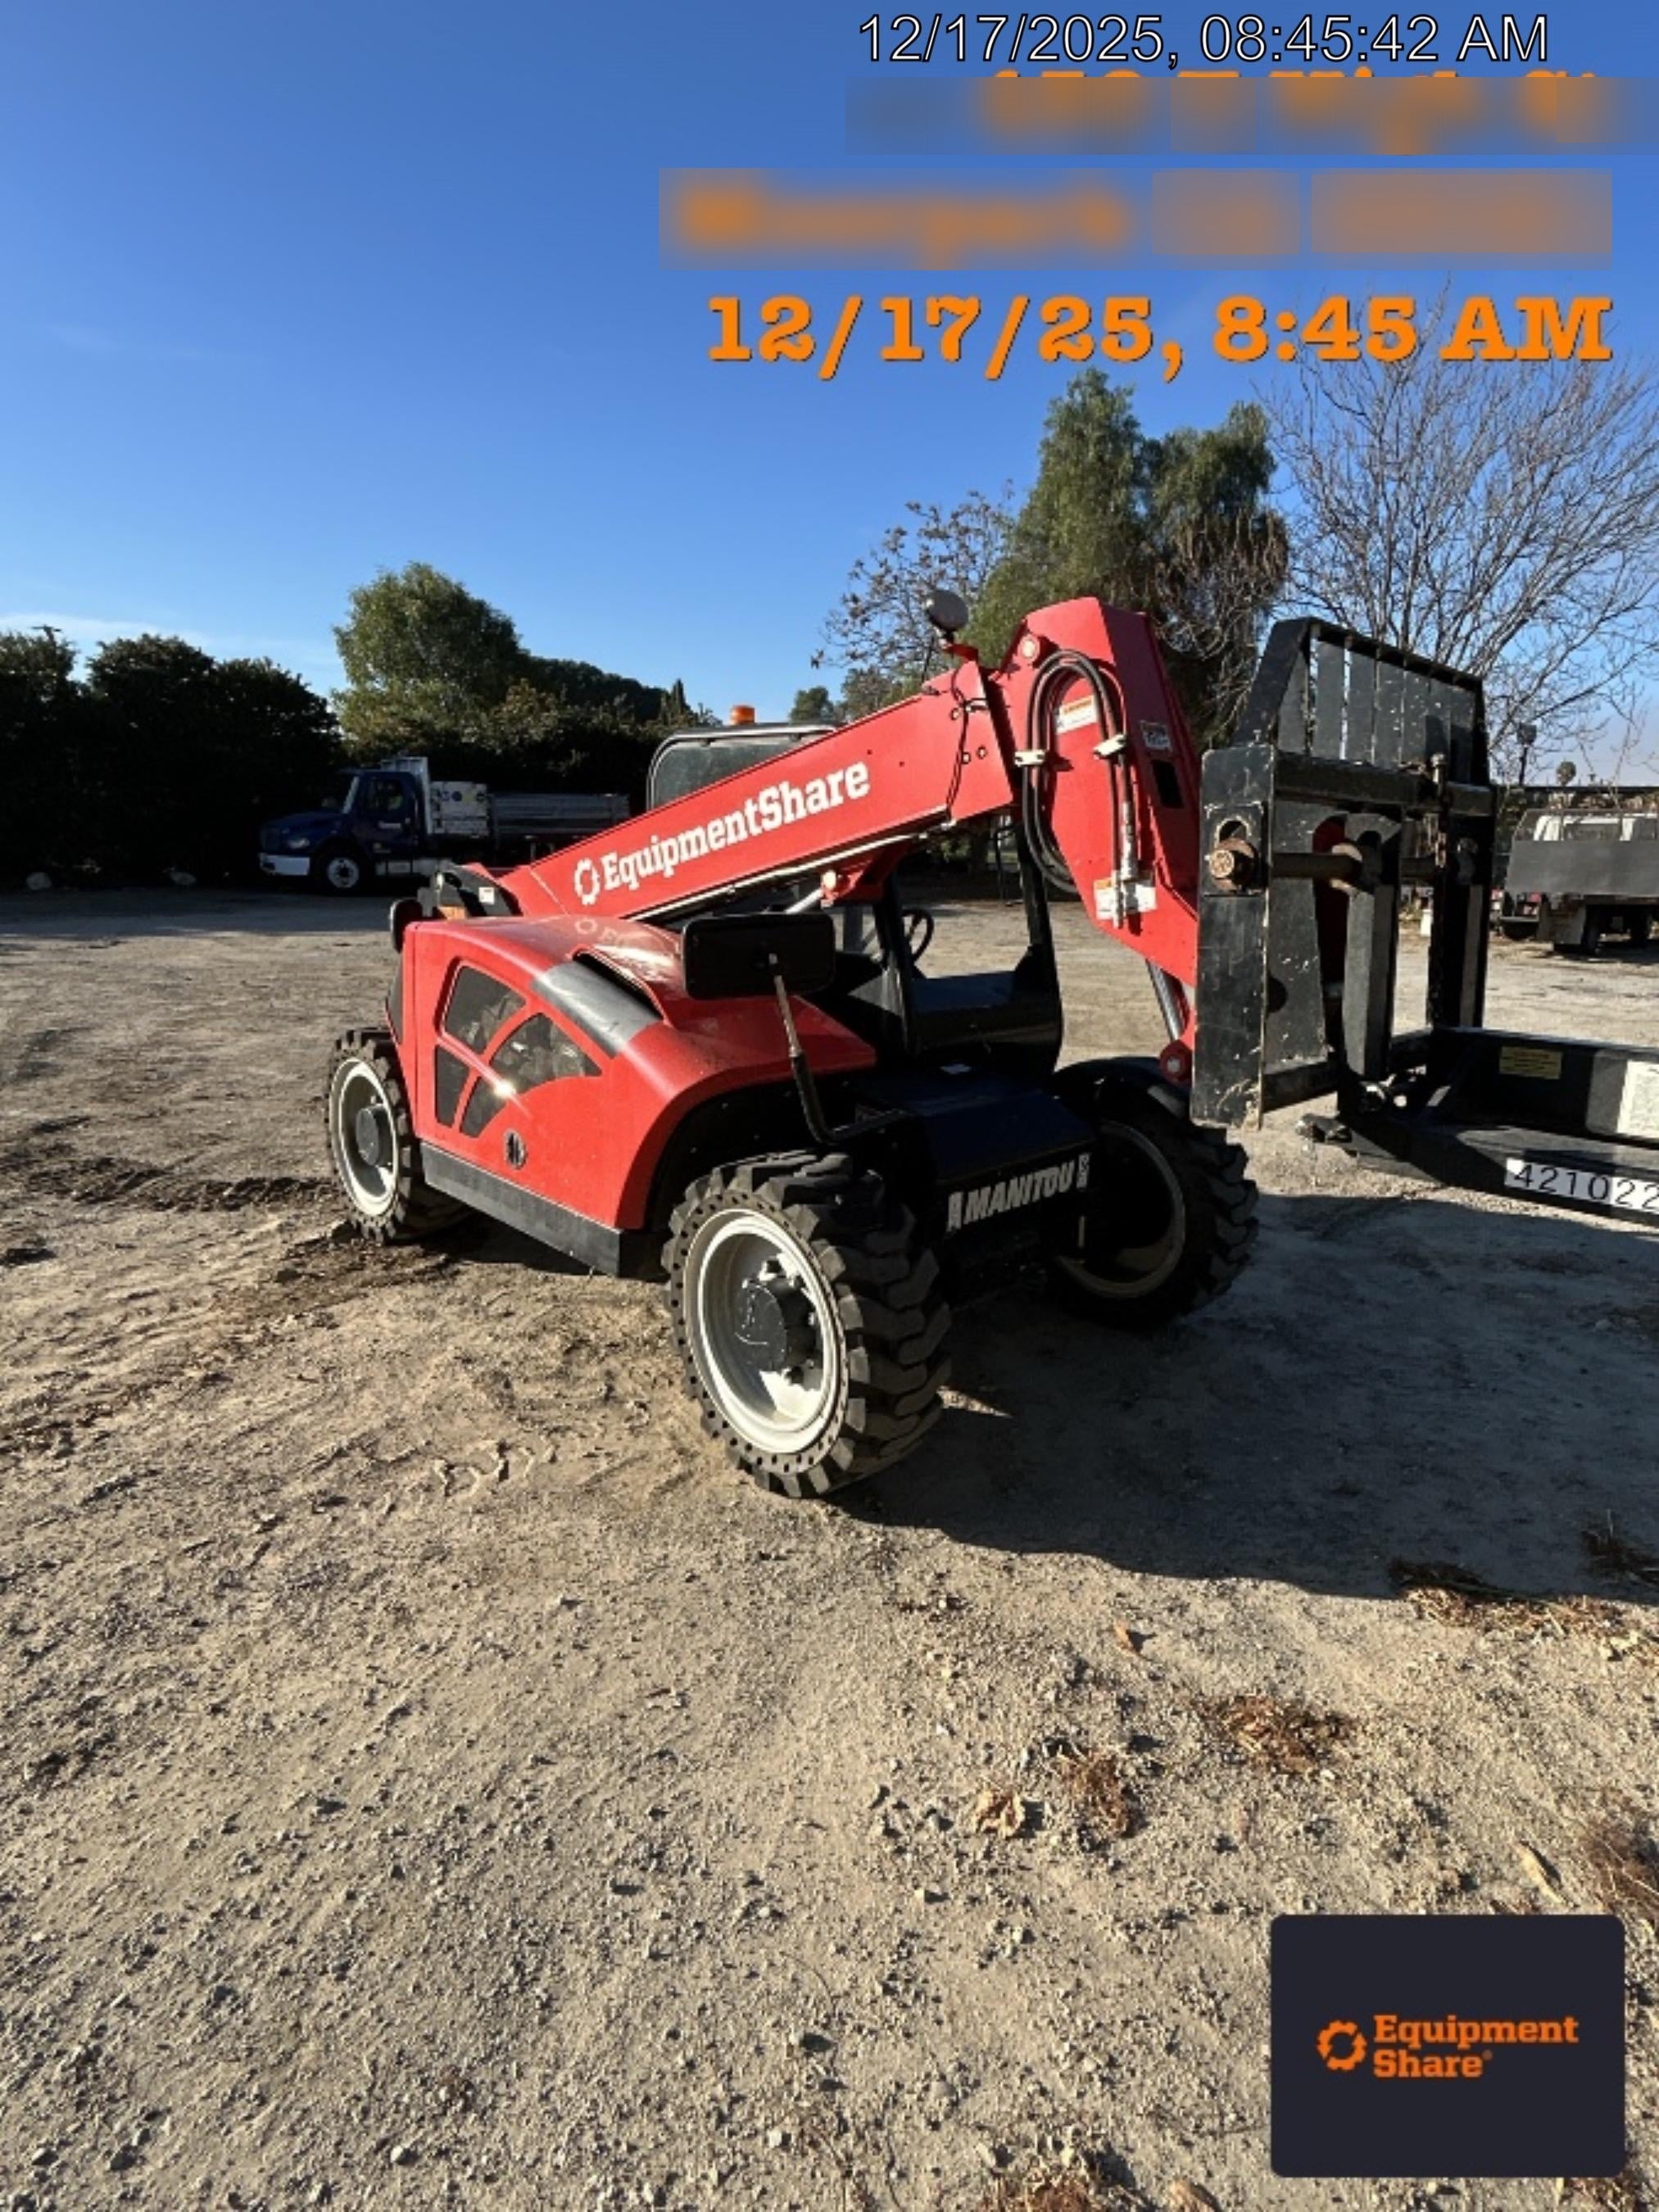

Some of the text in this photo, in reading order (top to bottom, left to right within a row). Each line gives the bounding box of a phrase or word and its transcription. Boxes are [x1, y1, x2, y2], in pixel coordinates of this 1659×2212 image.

[601, 761, 871, 891] EquipmentShare
[963, 1160, 1075, 1225] MANITOU
[1513, 1164, 1659, 1211] 421022
